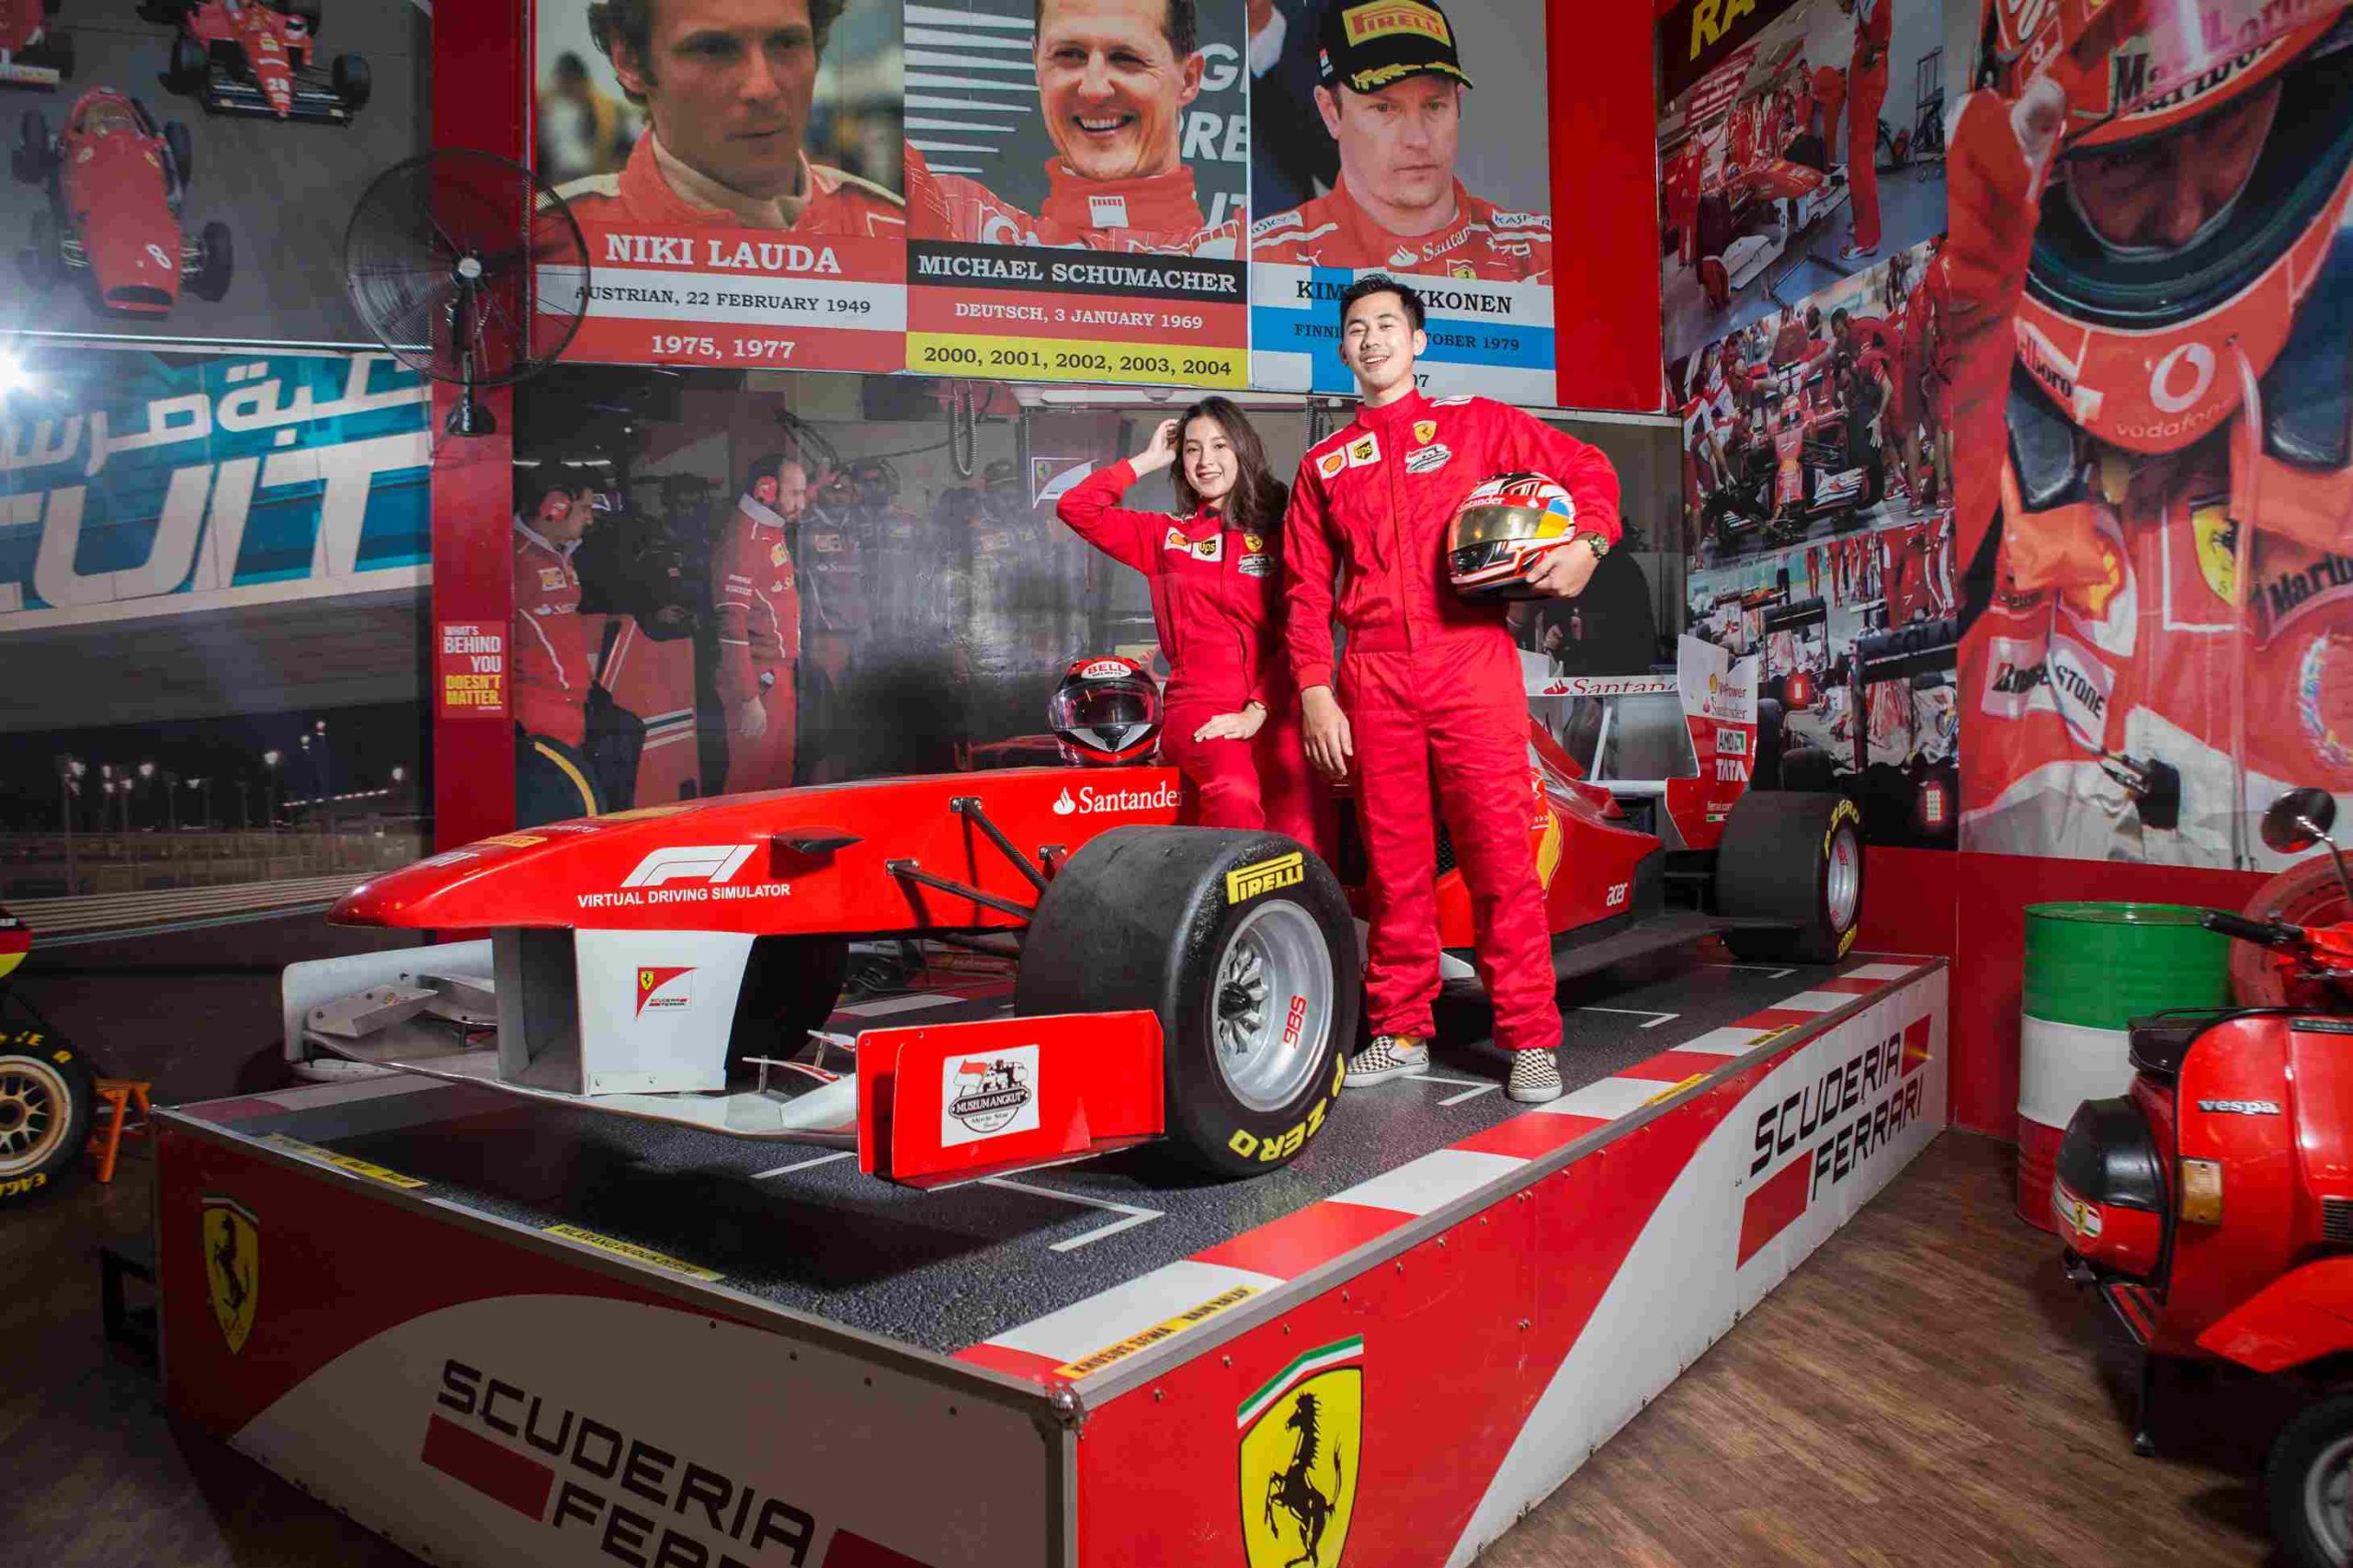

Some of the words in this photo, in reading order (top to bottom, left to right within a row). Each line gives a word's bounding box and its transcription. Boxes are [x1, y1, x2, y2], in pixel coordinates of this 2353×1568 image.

[1352, 6, 1444, 36] PIRELLI
[1179, 111, 1246, 163] RE
[605, 233, 695, 266] NIKI
[708, 239, 842, 275] LAUDA
[918, 255, 1044, 281] MICHAEL
[1051, 262, 1238, 294] SCHUMACHER
[574, 285, 680, 307] AUSTRIAN,
[686, 291, 710, 306] 22
[716, 293, 820, 312] FEBRUARY
[826, 299, 871, 314] 1949
[1416, 290, 1513, 314] KKONEN
[954, 302, 1049, 324] DEUTSCH,
[1054, 308, 1066, 321] 3
[1071, 309, 1155, 328] JANUARY
[1161, 314, 1204, 330] 1969
[651, 334, 723, 359] 1975,
[733, 337, 797, 359] 1977
[1294, 324, 1342, 339] FINNI
[1424, 331, 1477, 349] TOBER
[1483, 335, 1520, 352] 1979
[924, 346, 983, 367] 2000,
[990, 349, 1049, 369] 2001,
[1055, 353, 1113, 372] 2002,
[1119, 356, 1176, 376] 2003,
[1183, 359, 1232, 377] 2004
[444, 636, 502, 653] BEHIND
[471, 655, 502, 673] YOU
[1086, 664, 1124, 676] BELL
[446, 675, 502, 689] DOESN'T
[1715, 758, 1749, 782] TATA
[1226, 851, 1305, 904] PIRELLI
[577, 892, 644, 908] VIRTUAL
[648, 888, 708, 903] DRIVING
[711, 883, 790, 900] SIMULATOR
[1606, 881, 1629, 907] acer
[989, 1093, 1022, 1108] ANGKUT
[1749, 1031, 1901, 1179] SCUDERIA
[2200, 1099, 2279, 1116] vespa
[1228, 1097, 1327, 1163] ZERO
[1811, 1070, 1925, 1202] FERRARI
[437, 1358, 817, 1568] SCUDERIA
[552, 1479, 751, 1568] FER
